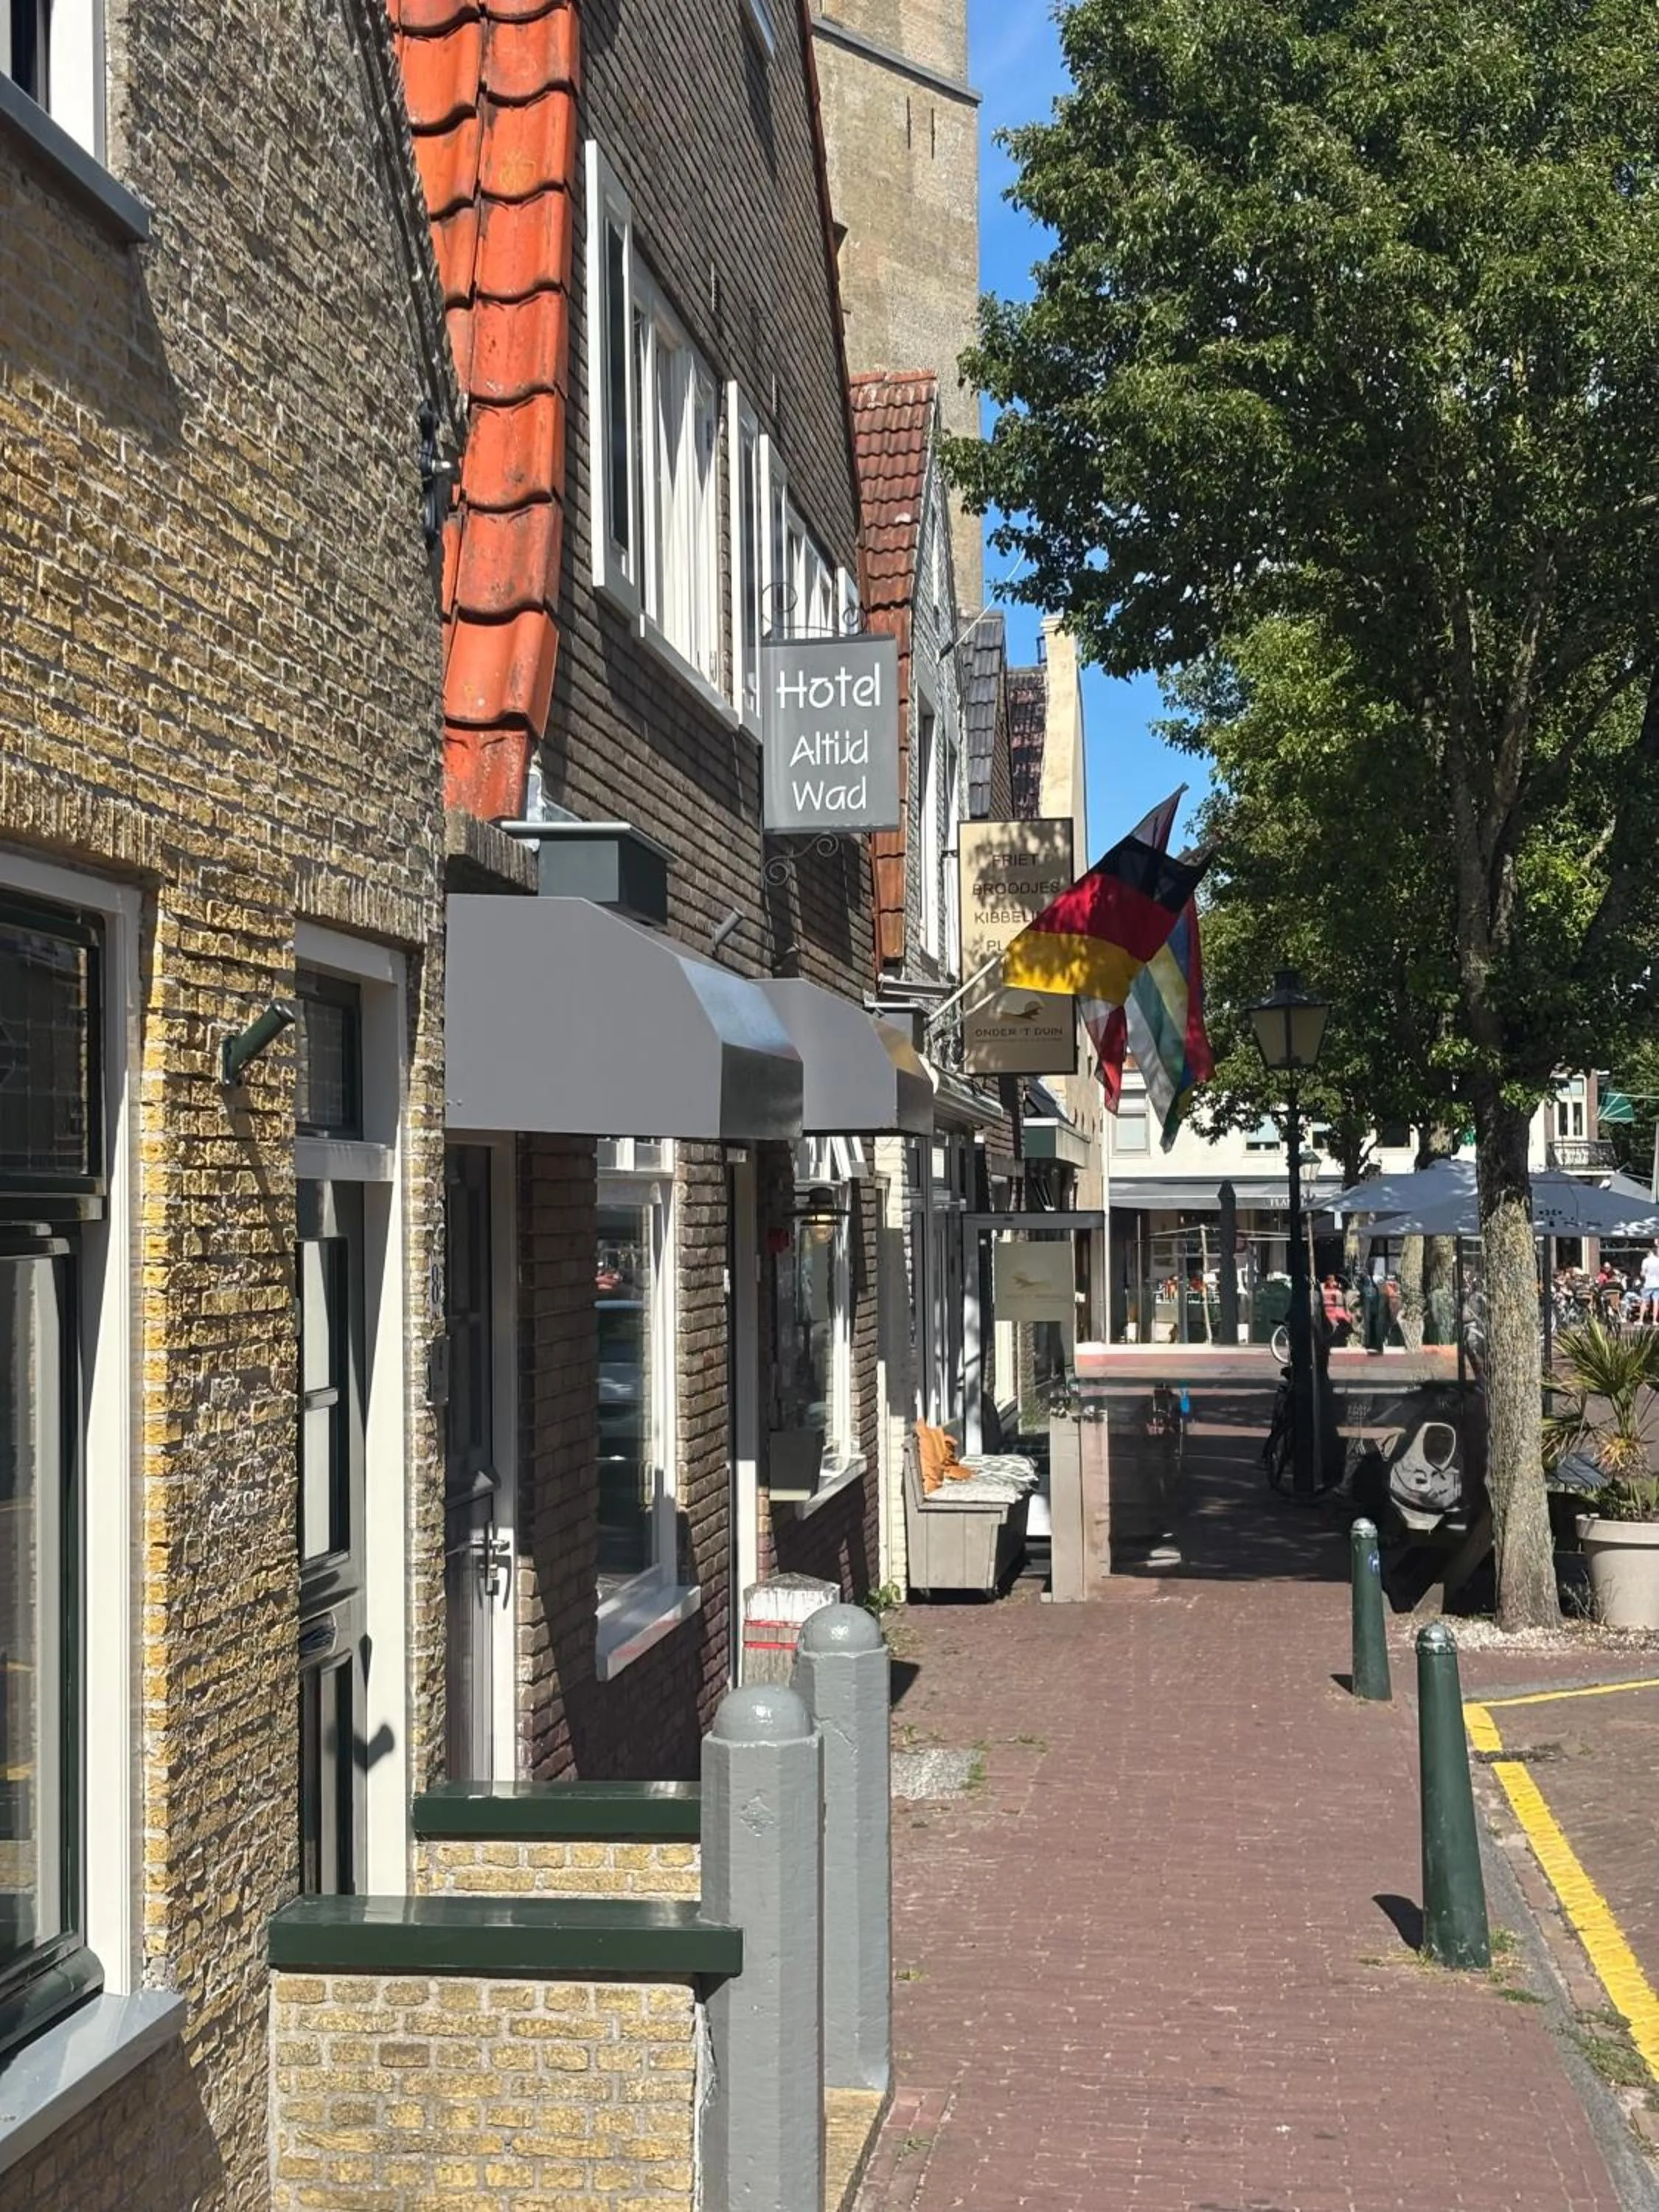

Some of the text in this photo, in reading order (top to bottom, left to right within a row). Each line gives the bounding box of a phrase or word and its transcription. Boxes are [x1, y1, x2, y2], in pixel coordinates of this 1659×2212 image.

[776, 662, 880, 709] Hotel
[790, 729, 868, 768] Altijd
[792, 775, 866, 811] Wad
[992, 854, 1038, 867] FRIET
[973, 881, 1060, 895] BROODJES
[974, 911, 1040, 924] KIBBELI
[1034, 1026, 1062, 1036] DUIN
